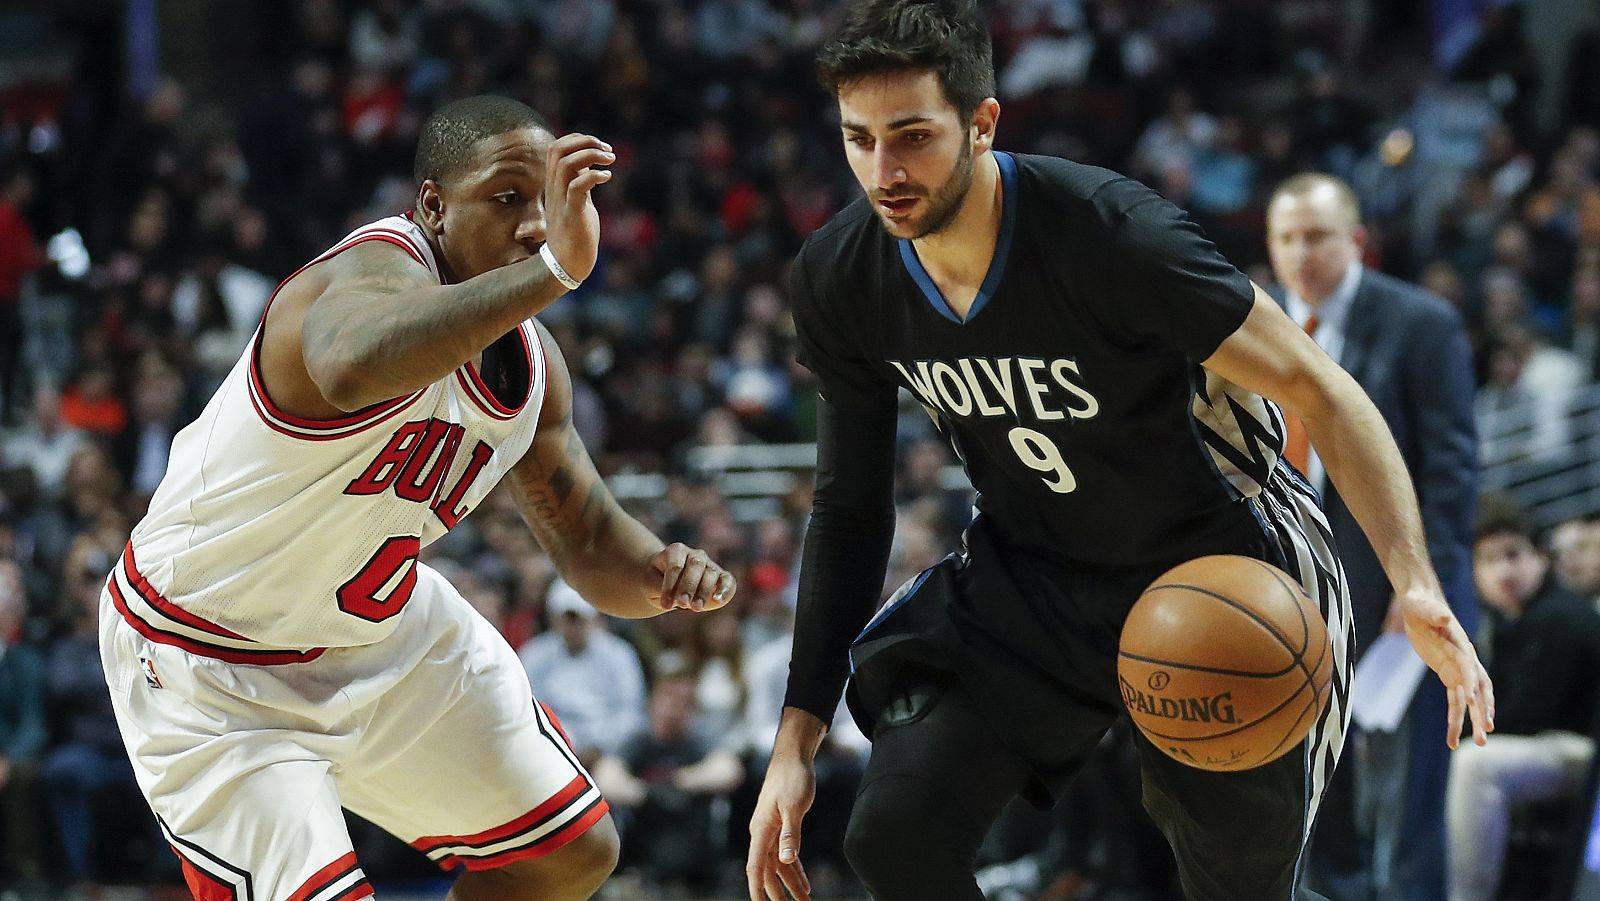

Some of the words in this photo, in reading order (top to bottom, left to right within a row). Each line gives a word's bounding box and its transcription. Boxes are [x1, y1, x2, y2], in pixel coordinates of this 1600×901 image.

[889, 357, 1099, 420] WOLVES
[1008, 427, 1077, 494] 9
[336, 535, 421, 623] 0
